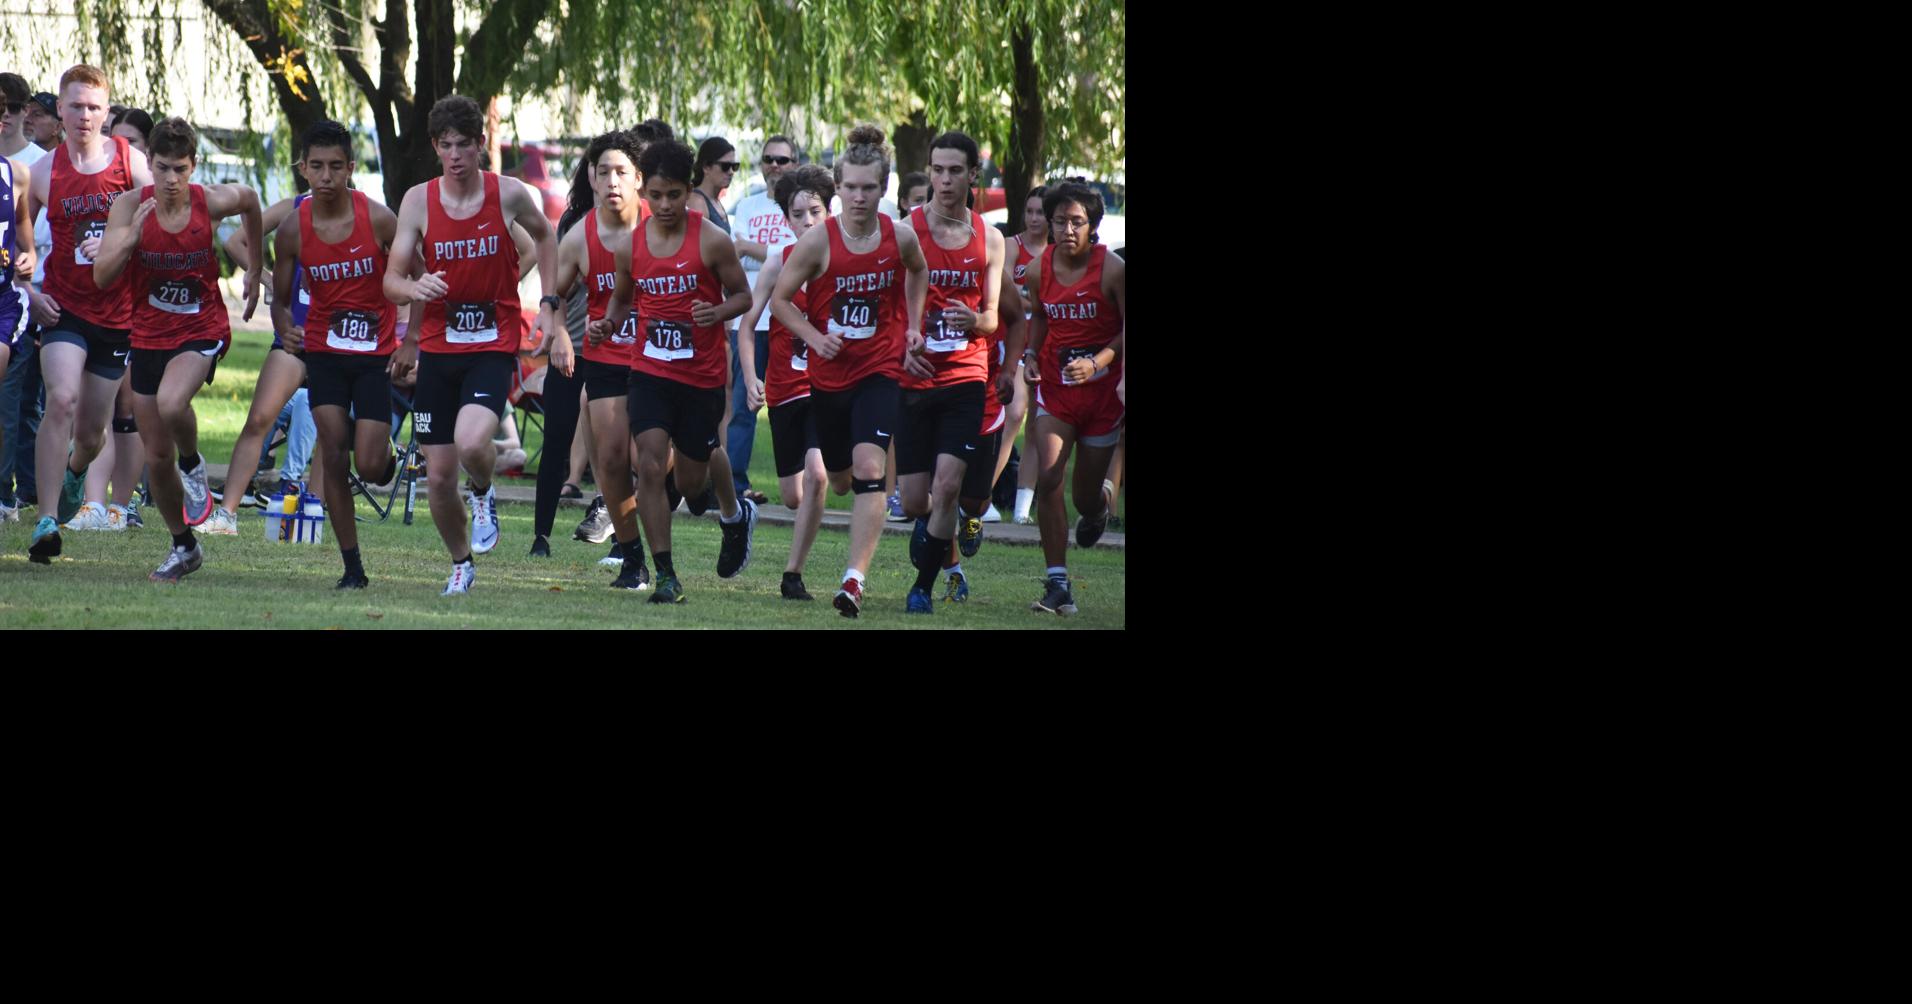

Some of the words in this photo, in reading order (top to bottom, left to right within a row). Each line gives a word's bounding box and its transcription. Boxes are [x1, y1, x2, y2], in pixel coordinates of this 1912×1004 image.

[434, 235, 499, 261] POTEAU
[139, 248, 209, 270] WILDCATS
[309, 257, 374, 282] POTEAU
[596, 272, 616, 292] PO
[637, 274, 697, 295] POTEAU
[159, 286, 189, 304] 278
[455, 311, 486, 330] 202
[841, 304, 870, 326] 140
[341, 318, 369, 339] 180
[655, 328, 682, 348] 178
